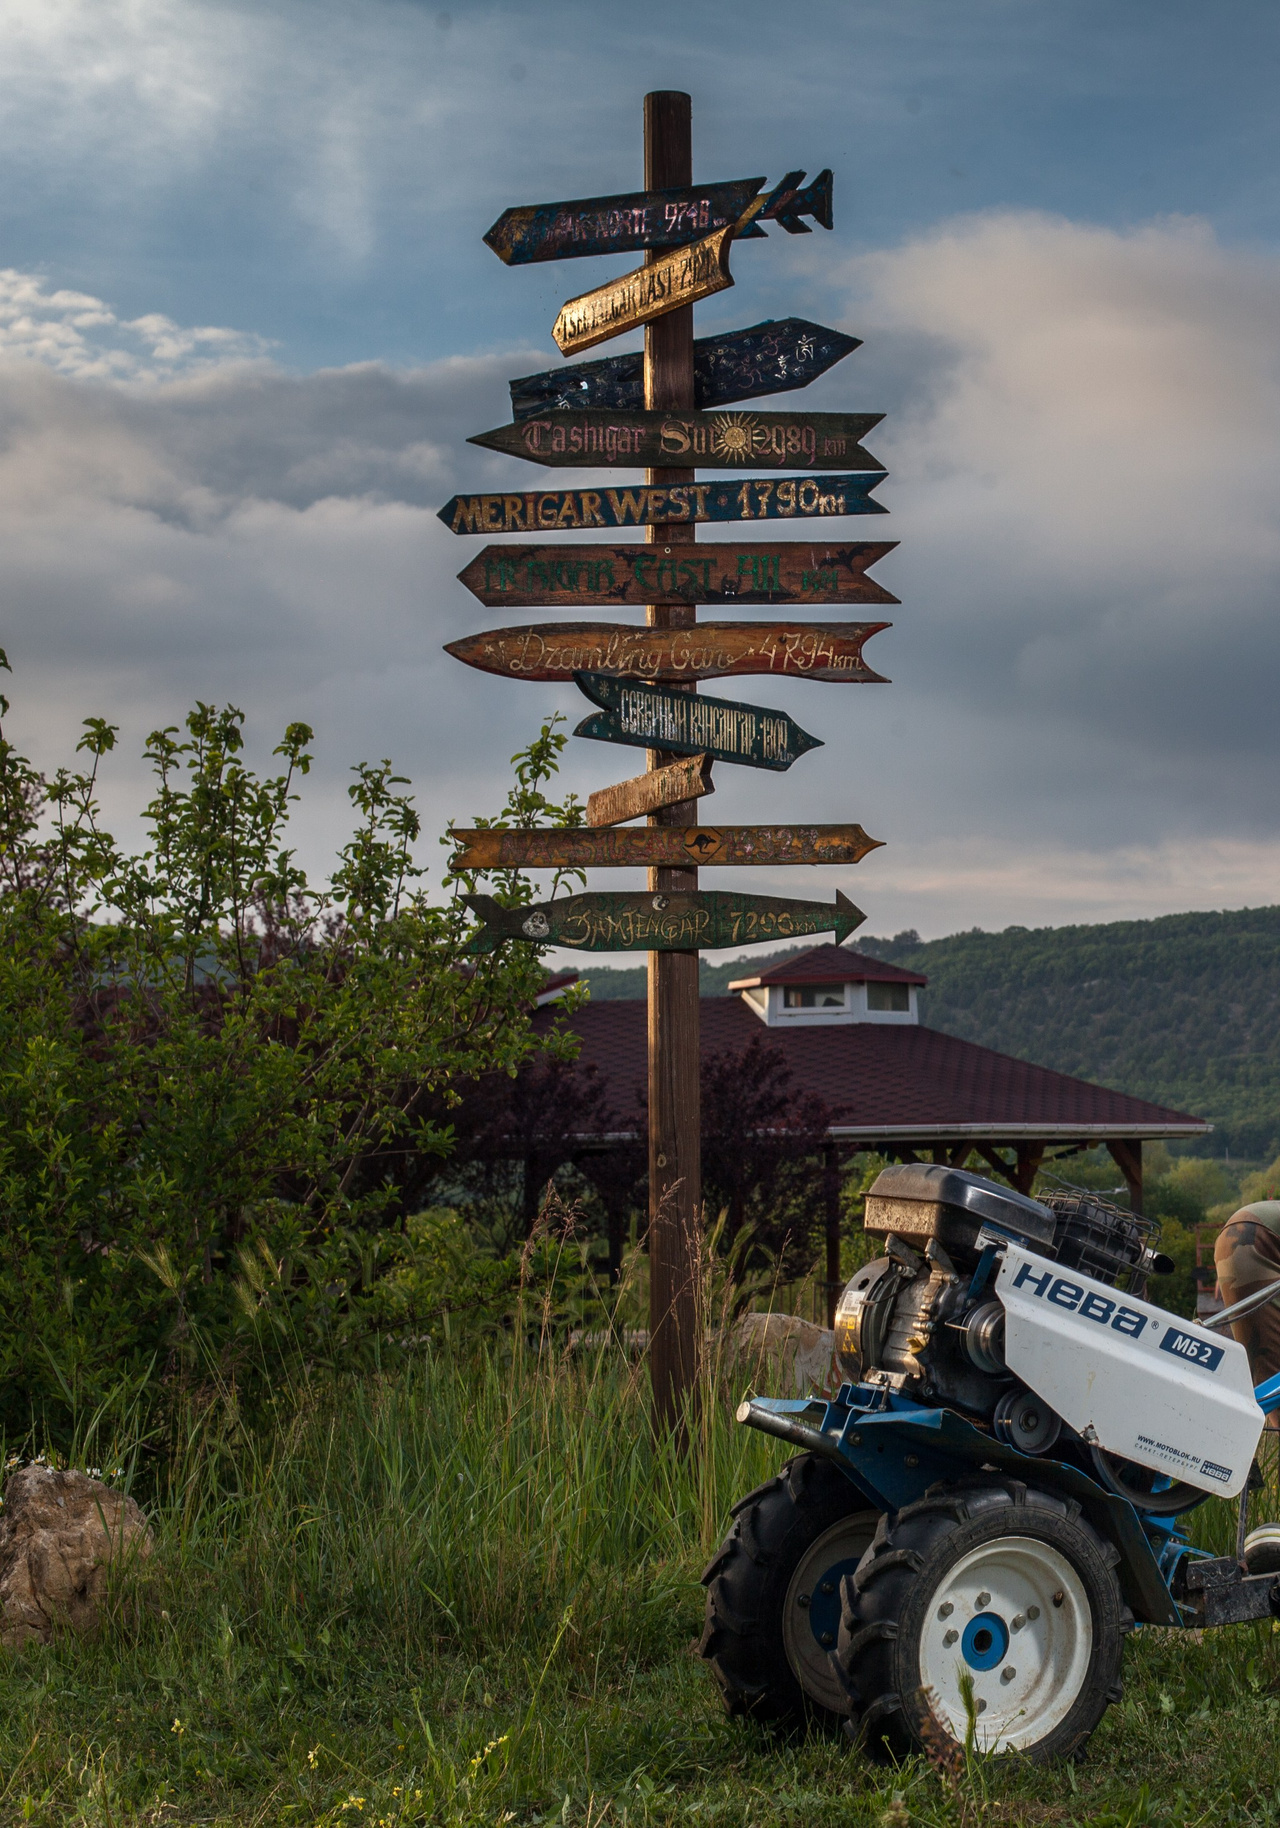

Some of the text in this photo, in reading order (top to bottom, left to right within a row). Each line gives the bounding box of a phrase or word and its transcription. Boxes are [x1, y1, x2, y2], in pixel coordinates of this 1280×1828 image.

[521, 420, 646, 462] Tashigar
[824, 437, 847, 457] km
[451, 490, 606, 533] MERIGAR
[605, 484, 711, 525] WEST
[484, 556, 616, 594] MERIGAR
[634, 555, 718, 592] EAST
[509, 627, 662, 678] Dzamling
[671, 631, 745, 670] Gar
[1198, 1348, 1213, 1363] 2
[1134, 1442, 1199, 1470] САНКТ-ПЕТЕРБУРГ
[1137, 1434, 1202, 1464] WWW.MOTOBLOK.RU
